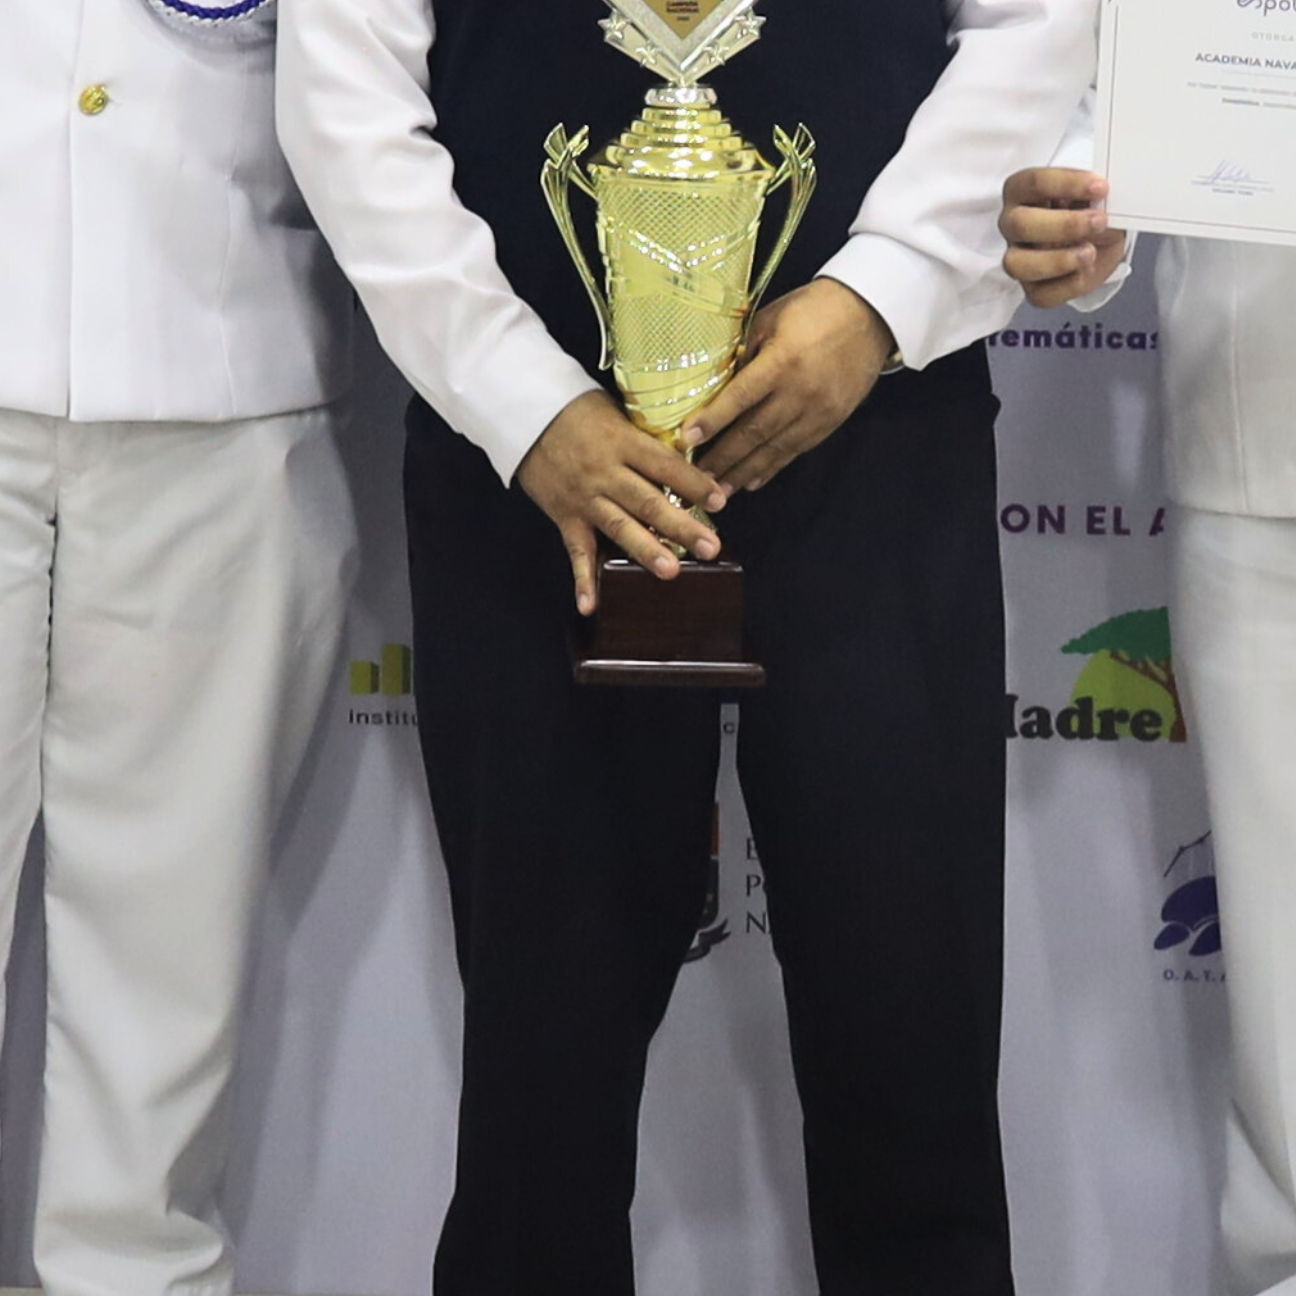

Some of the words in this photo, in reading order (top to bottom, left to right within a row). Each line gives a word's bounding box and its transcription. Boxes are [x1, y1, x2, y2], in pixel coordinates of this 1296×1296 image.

[1195, 52, 1261, 67] ACADEMIA
[1000, 503, 1066, 534] ON
[1086, 506, 1131, 536] EL
